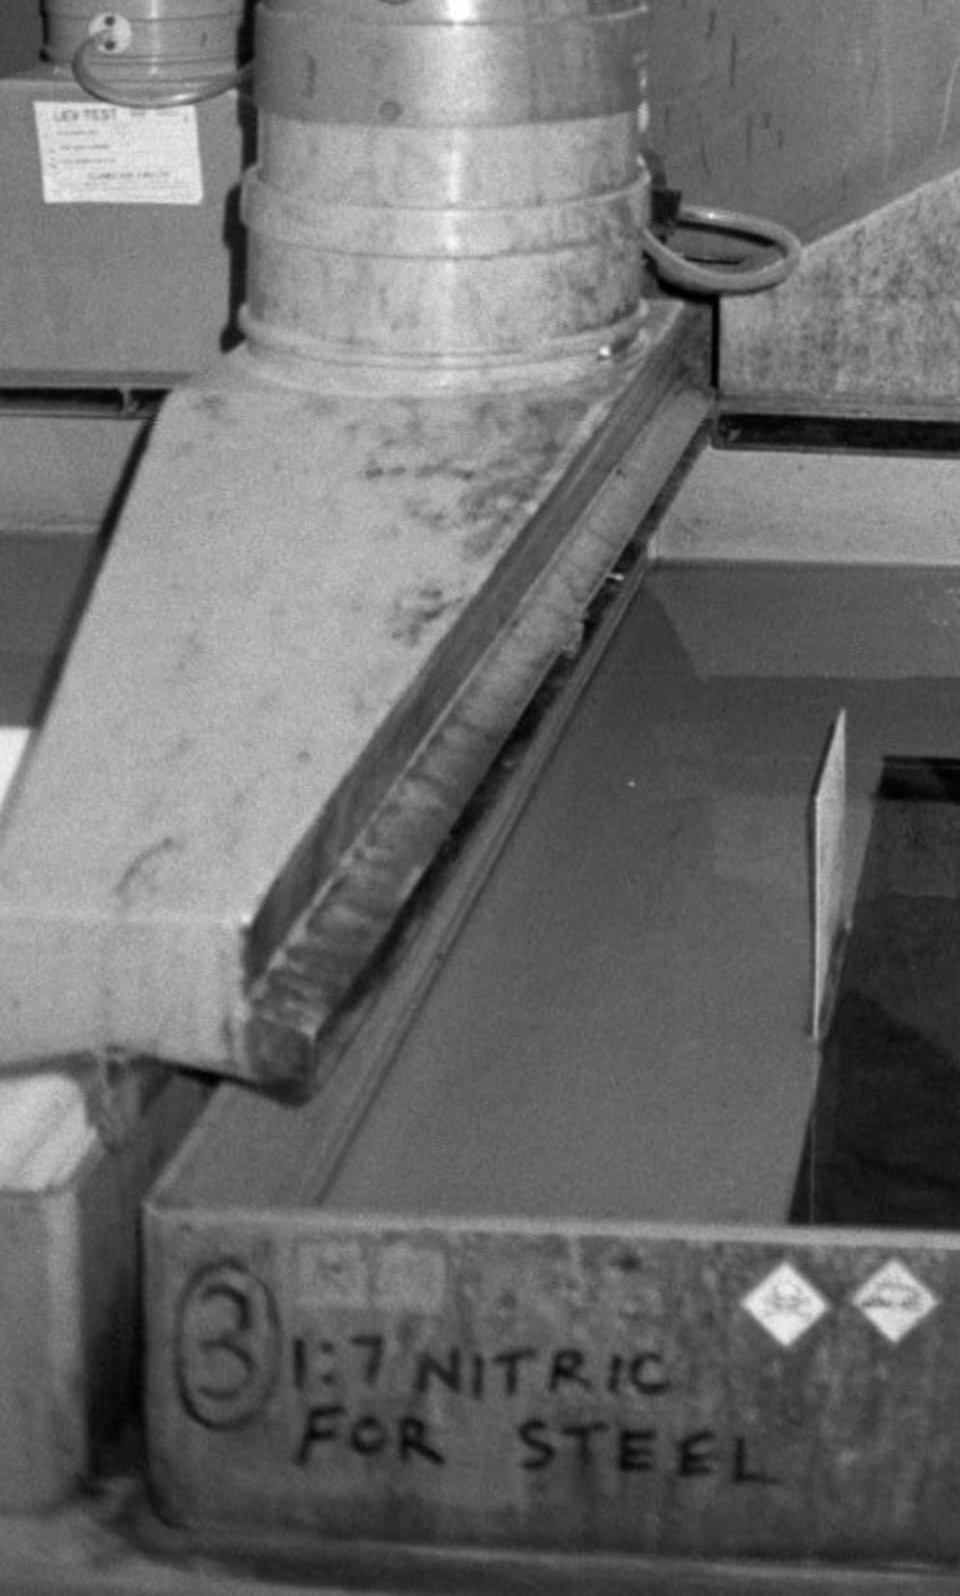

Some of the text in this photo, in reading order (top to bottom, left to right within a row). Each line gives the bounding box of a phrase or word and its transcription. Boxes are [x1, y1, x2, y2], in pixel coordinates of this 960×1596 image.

[86, 108, 117, 121] TEST
[199, 1280, 256, 1402] 3
[292, 1334, 674, 1400] 1:7 NITRIC
[294, 1403, 781, 1486] FOR STEEL
